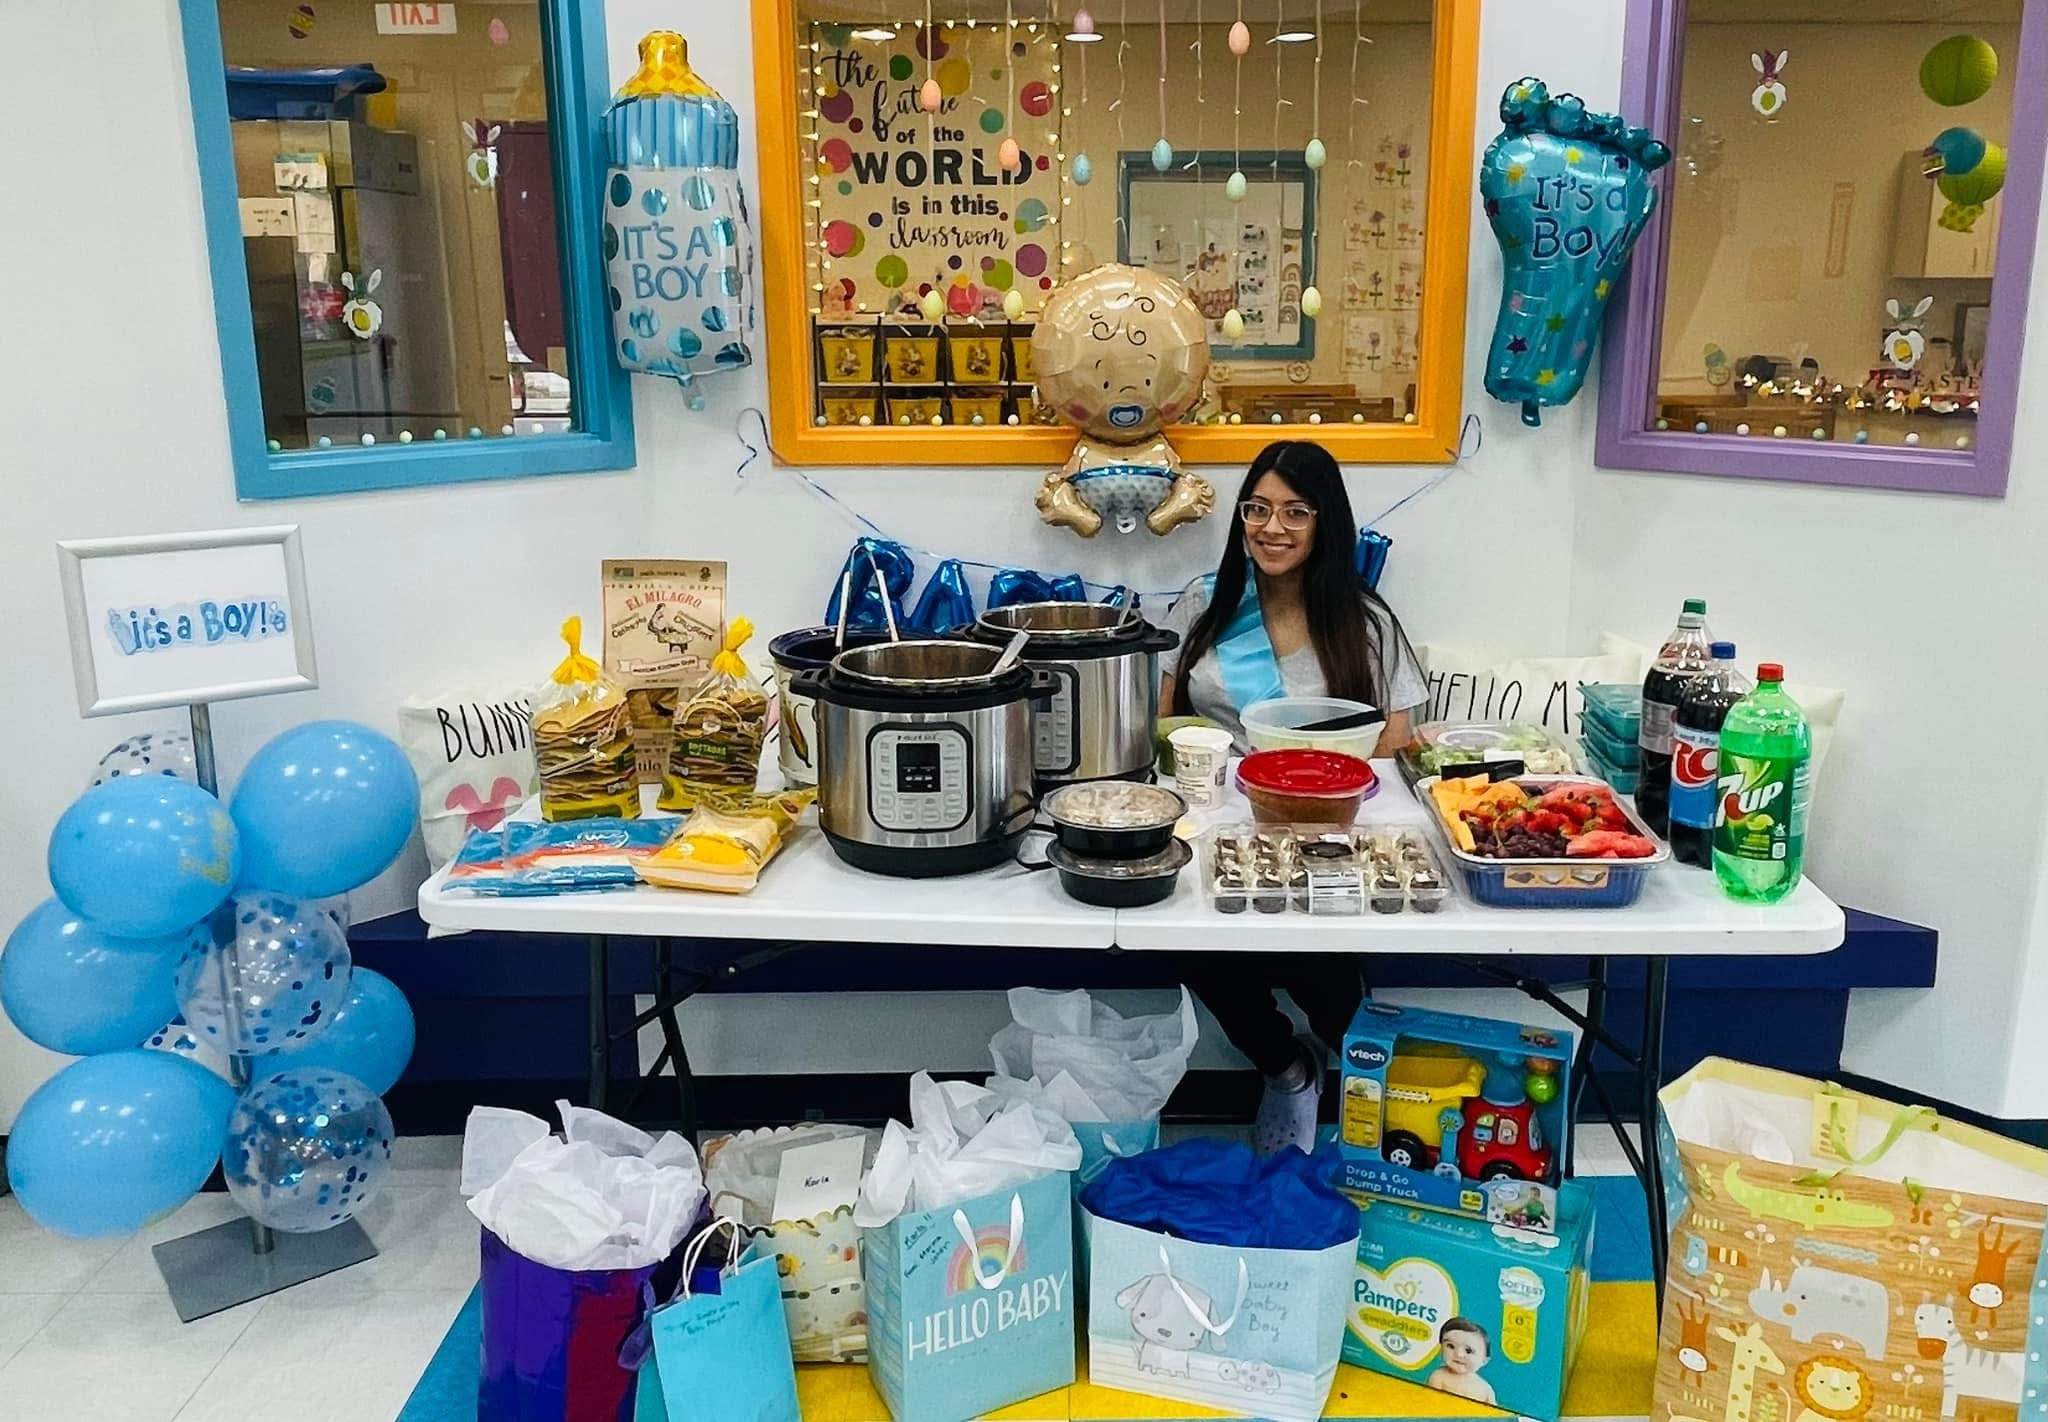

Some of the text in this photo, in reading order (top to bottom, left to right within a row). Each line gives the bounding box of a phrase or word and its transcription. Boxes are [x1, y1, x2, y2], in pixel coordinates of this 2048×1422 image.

[820, 49, 879, 88] the
[872, 80, 960, 142] futre
[896, 126, 965, 144] of the
[852, 148, 1032, 187] WORLD
[892, 194, 999, 215] is in this
[1532, 175, 1627, 212] It's a
[624, 221, 712, 261] IT'S A
[890, 217, 1009, 250] classroom
[1532, 217, 1634, 269] Boy!
[632, 263, 709, 301] BOY
[625, 590, 703, 611] EL MILAGRO
[130, 601, 267, 649] it's a Boy!
[1349, 1049, 1385, 1062] vtech
[1346, 1165, 1409, 1185] Drop & Go
[1346, 1177, 1418, 1199] Dump Truck
[909, 1270, 1068, 1361] HELLO BABY
[1354, 1279, 1438, 1323] Pampers
